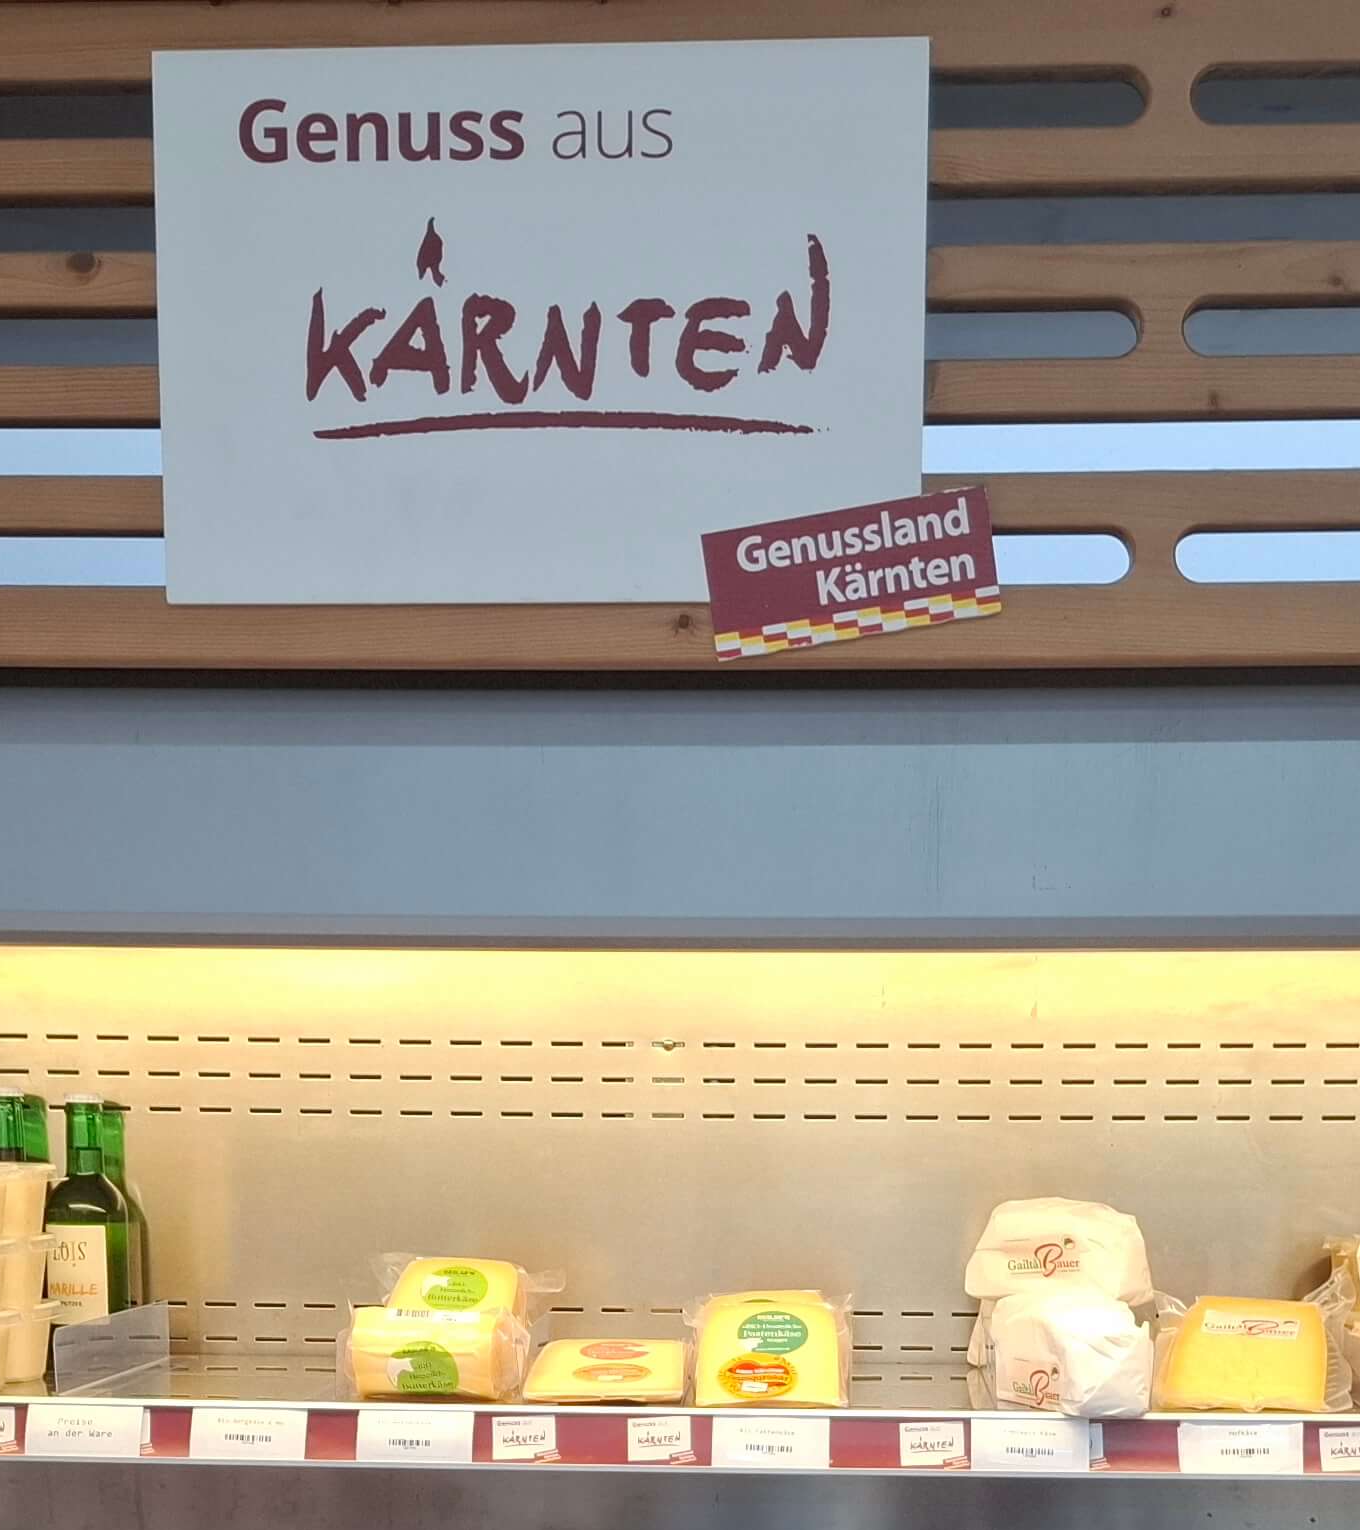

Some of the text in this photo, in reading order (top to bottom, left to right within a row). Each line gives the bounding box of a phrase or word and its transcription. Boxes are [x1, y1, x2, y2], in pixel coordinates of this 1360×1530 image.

[238, 98, 673, 164] Genuss aus
[736, 498, 970, 575] Genussland
[815, 552, 976, 607] Kärnten
[47, 1428, 113, 1438] an der Ware
